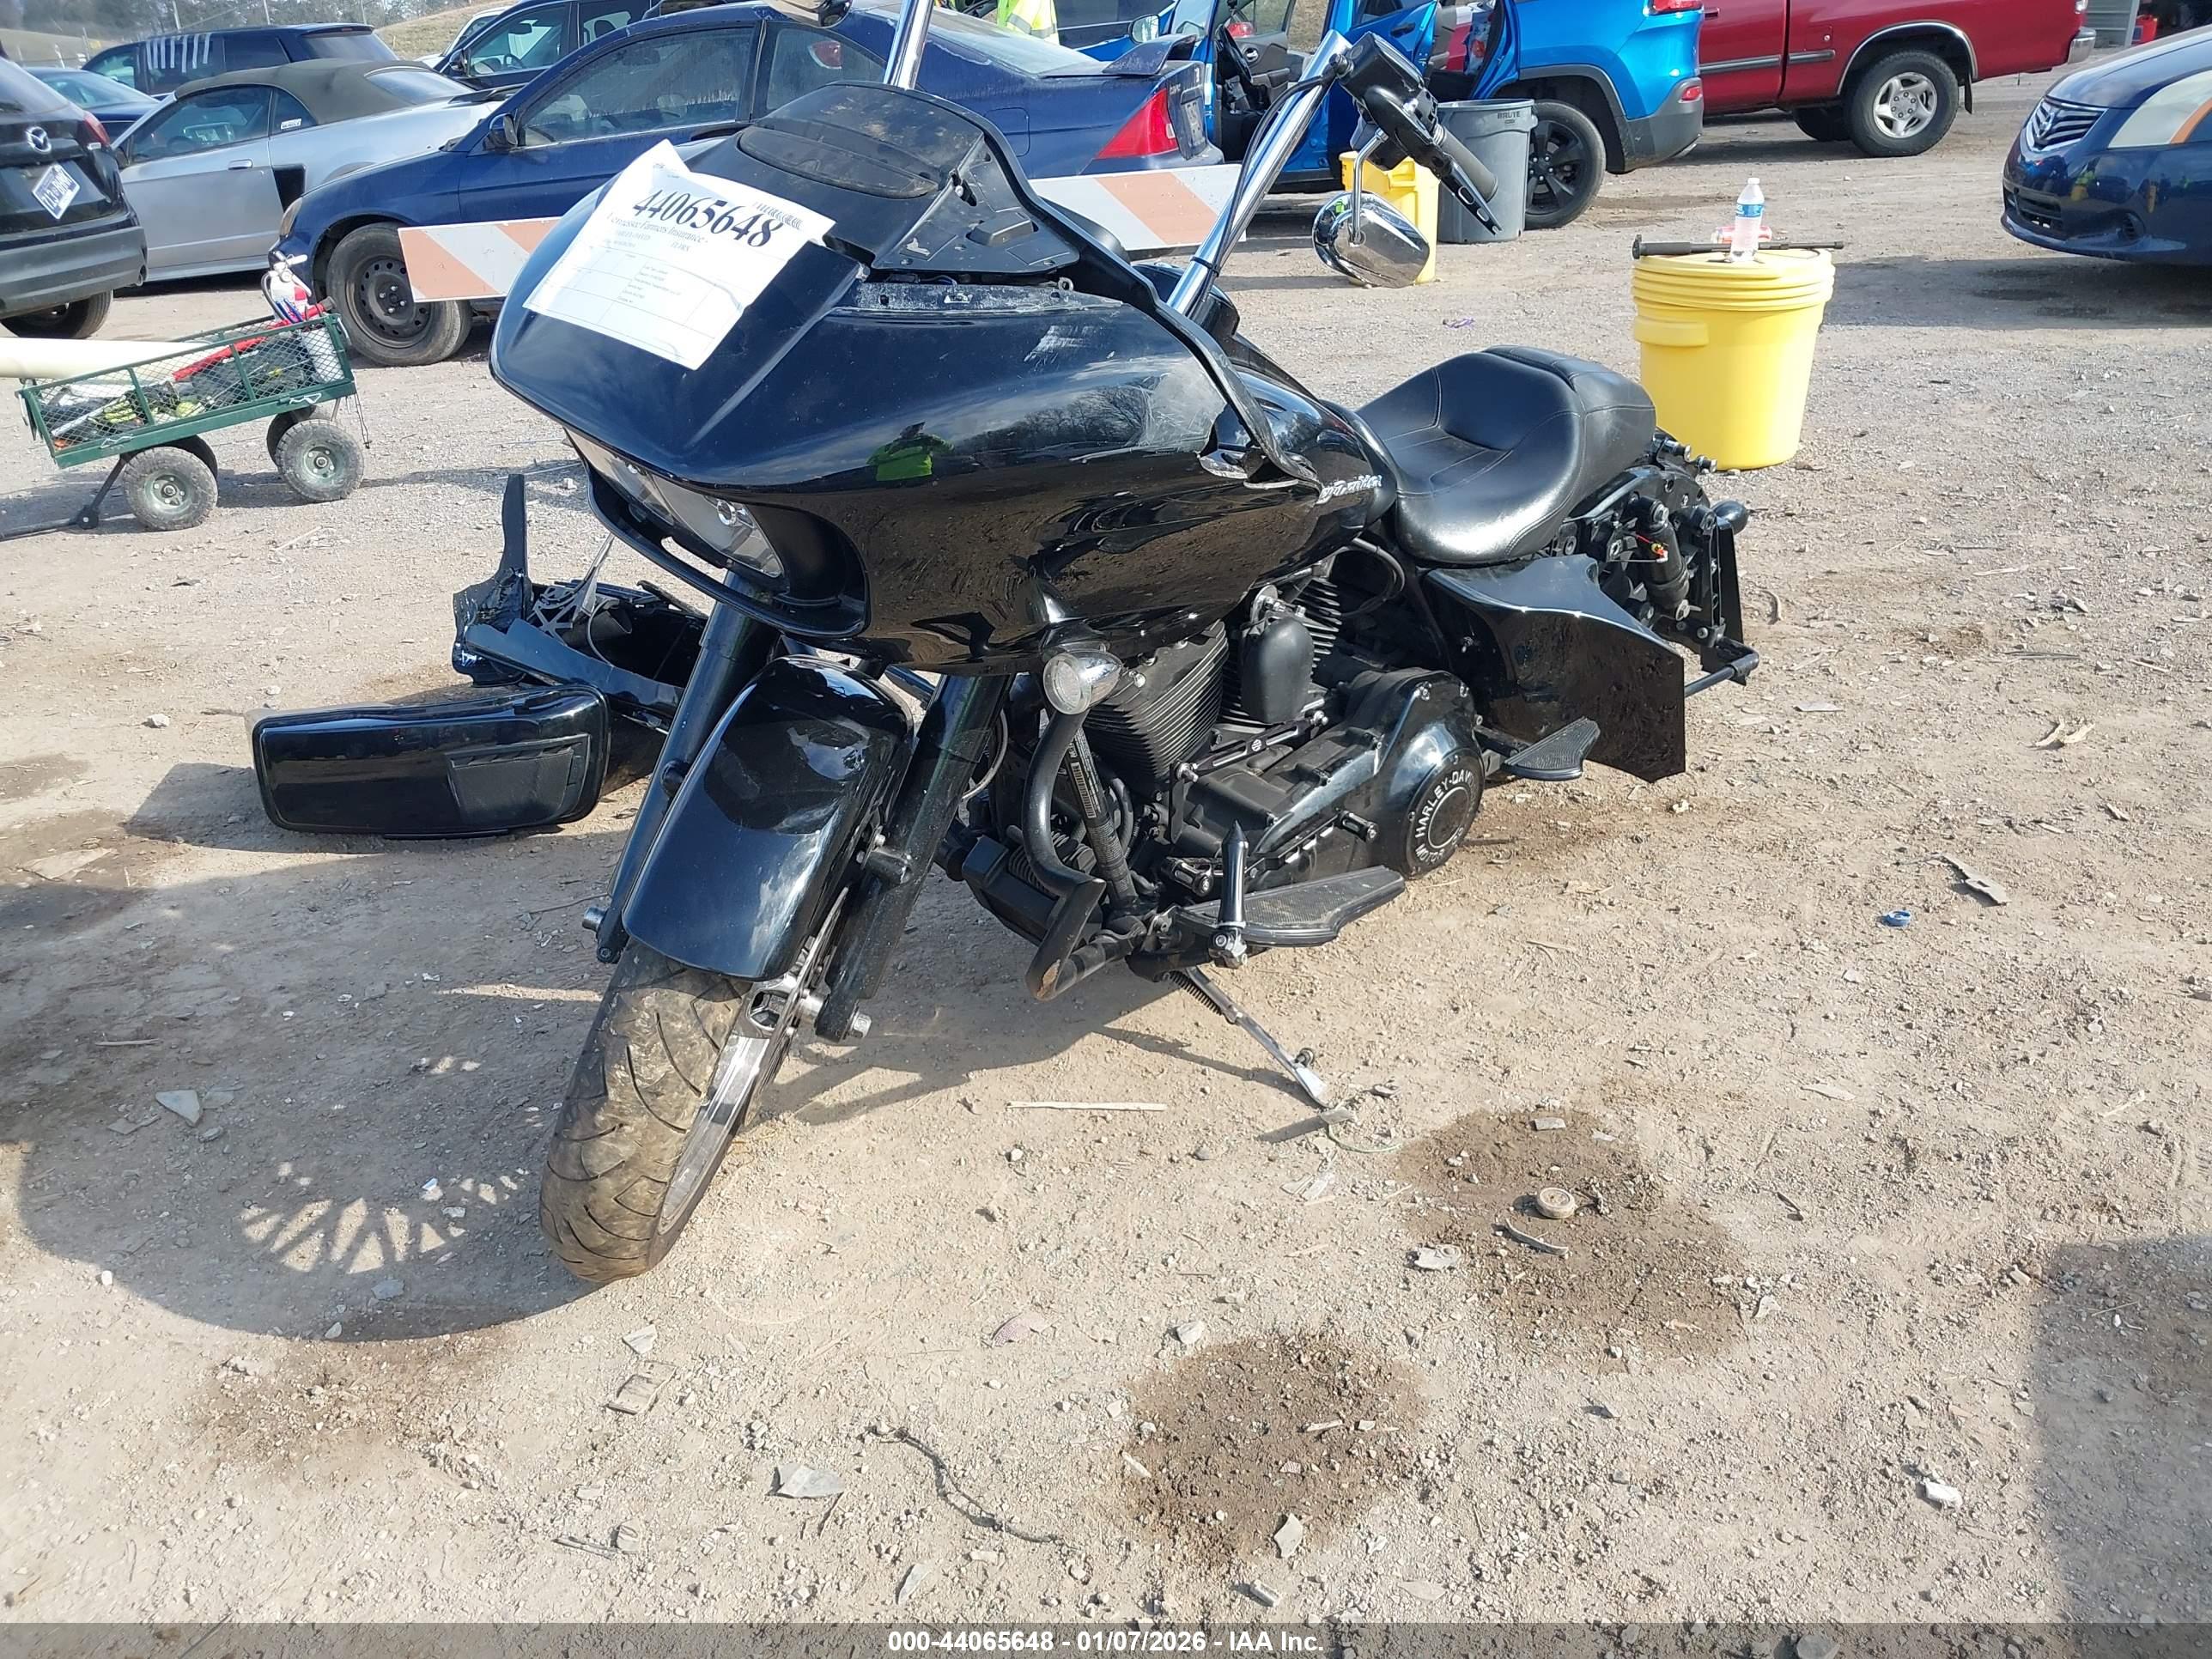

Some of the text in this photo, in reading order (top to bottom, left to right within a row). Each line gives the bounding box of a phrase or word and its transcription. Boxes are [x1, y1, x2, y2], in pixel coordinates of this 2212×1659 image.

[633, 189, 784, 247] 44065648
[639, 220, 668, 234] Farmers
[667, 226, 702, 244] Insurance
[1414, 842, 1446, 863] MOTOR
